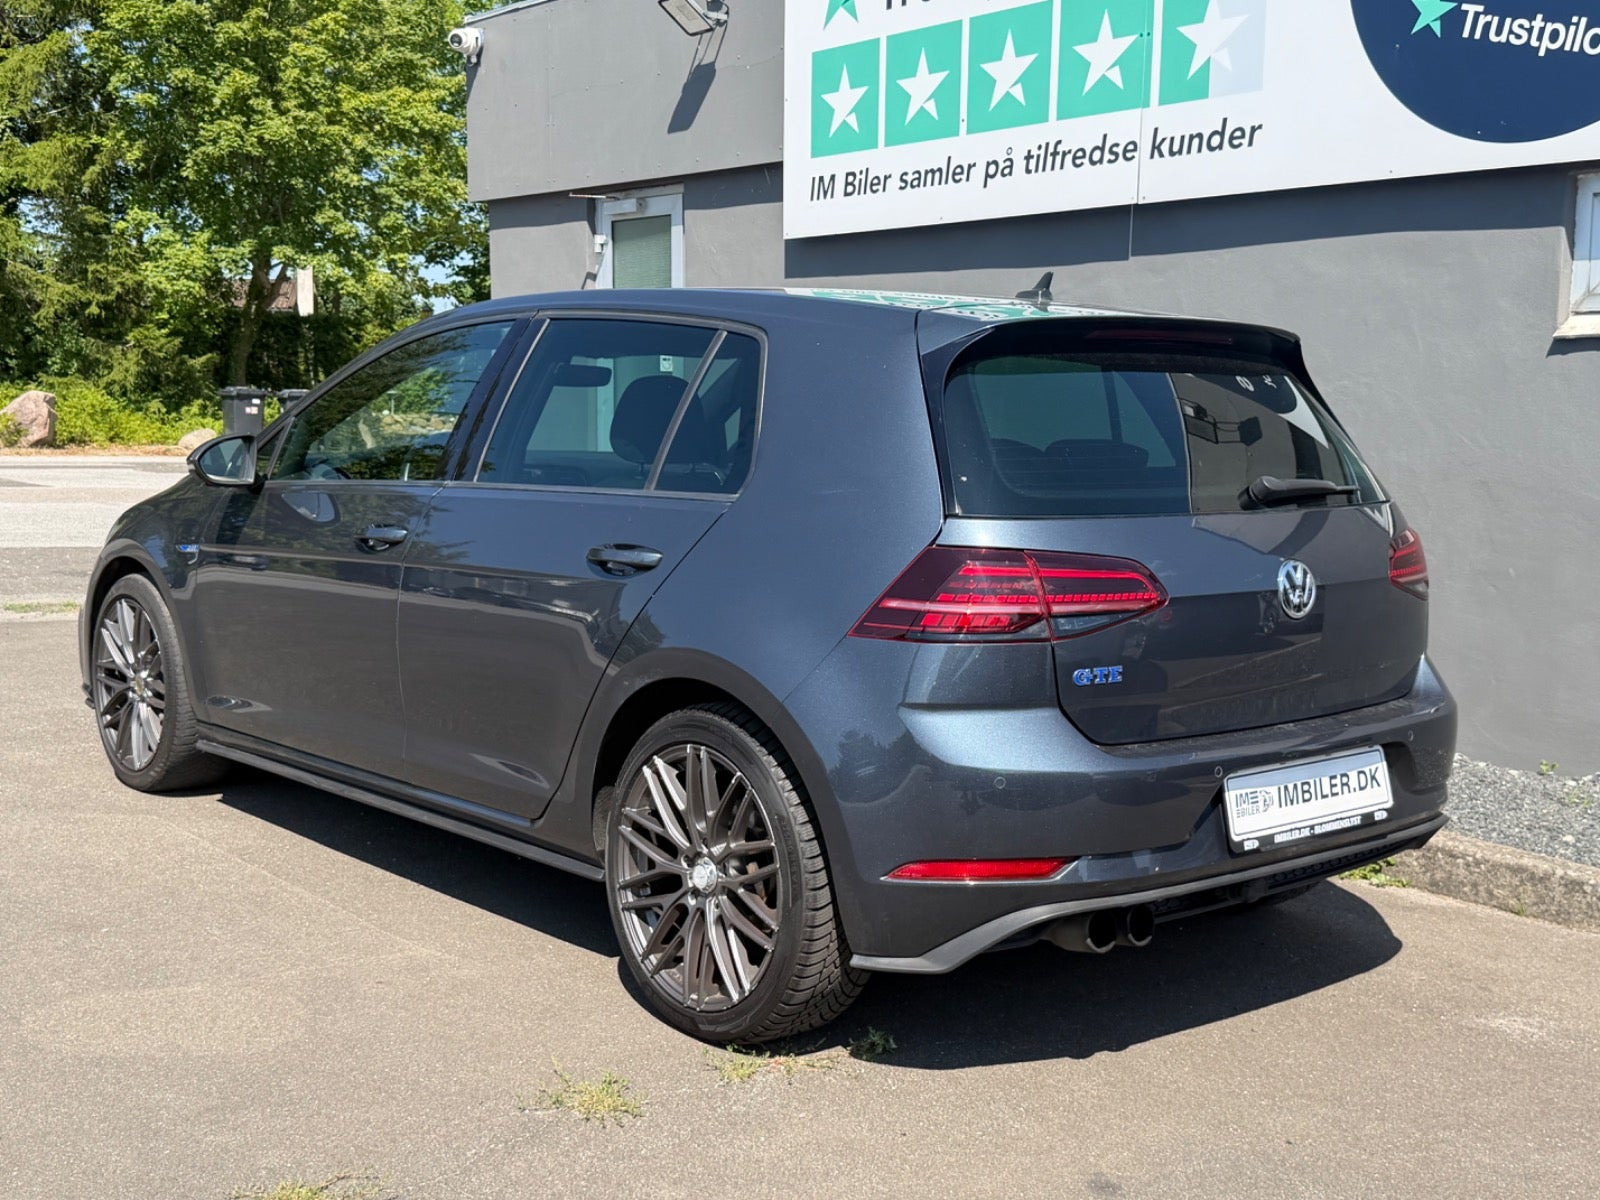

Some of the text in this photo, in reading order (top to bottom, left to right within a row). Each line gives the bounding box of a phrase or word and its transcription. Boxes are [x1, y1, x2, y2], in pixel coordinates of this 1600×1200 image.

[810, 117, 1264, 201] IM Biler samler på tilfredse kunder
[1072, 665, 1124, 687] GTE
[1277, 766, 1381, 808] IMBILER.DK
